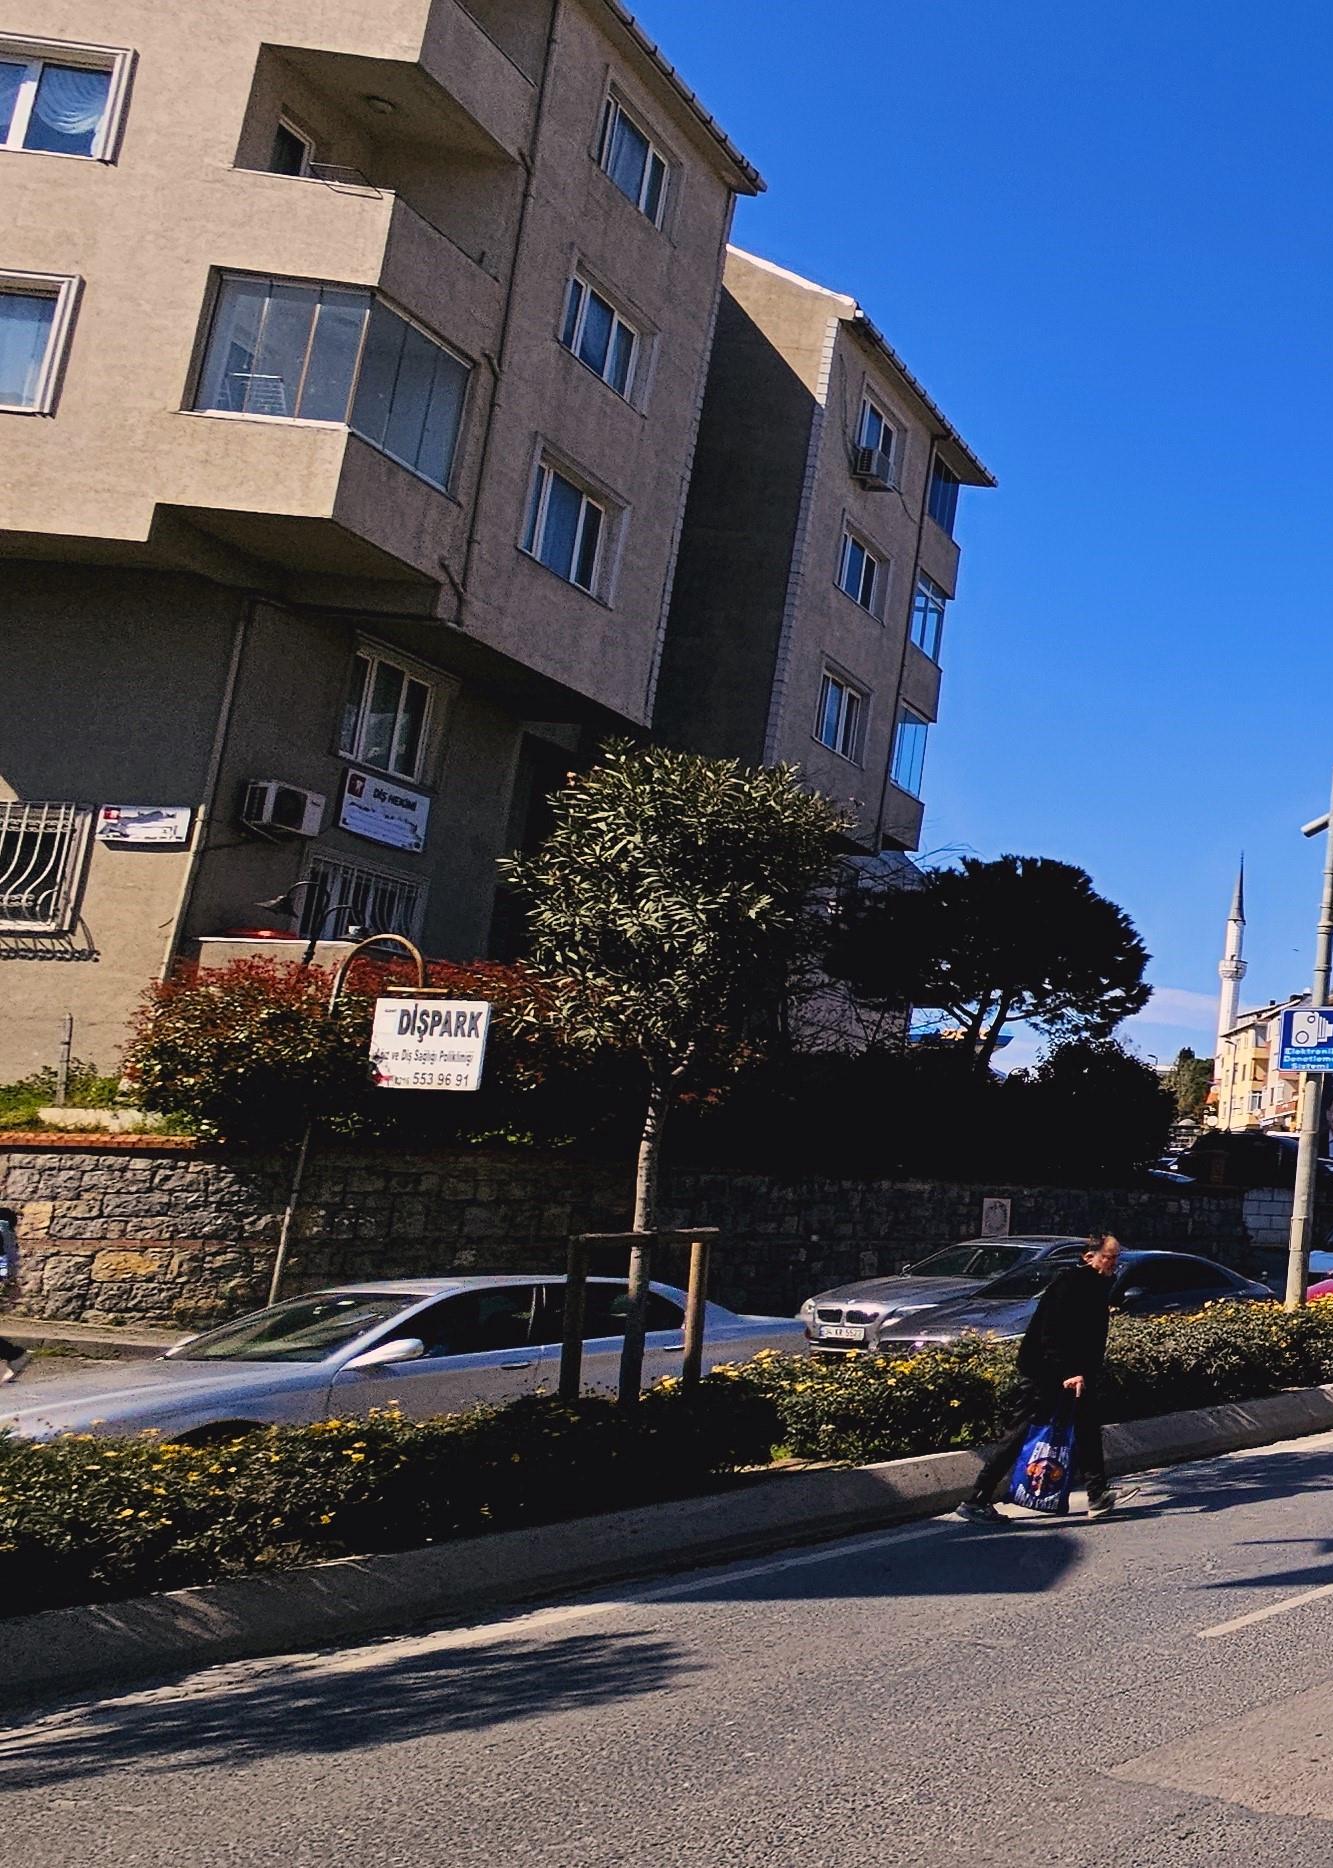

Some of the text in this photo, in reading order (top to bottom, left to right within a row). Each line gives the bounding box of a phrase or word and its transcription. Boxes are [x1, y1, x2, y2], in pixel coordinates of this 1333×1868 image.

[397, 1003, 482, 1043] DİŞPARK
[412, 1072, 433, 1085] 553
[437, 1073, 451, 1086] 96
[455, 1073, 468, 1087] 91
